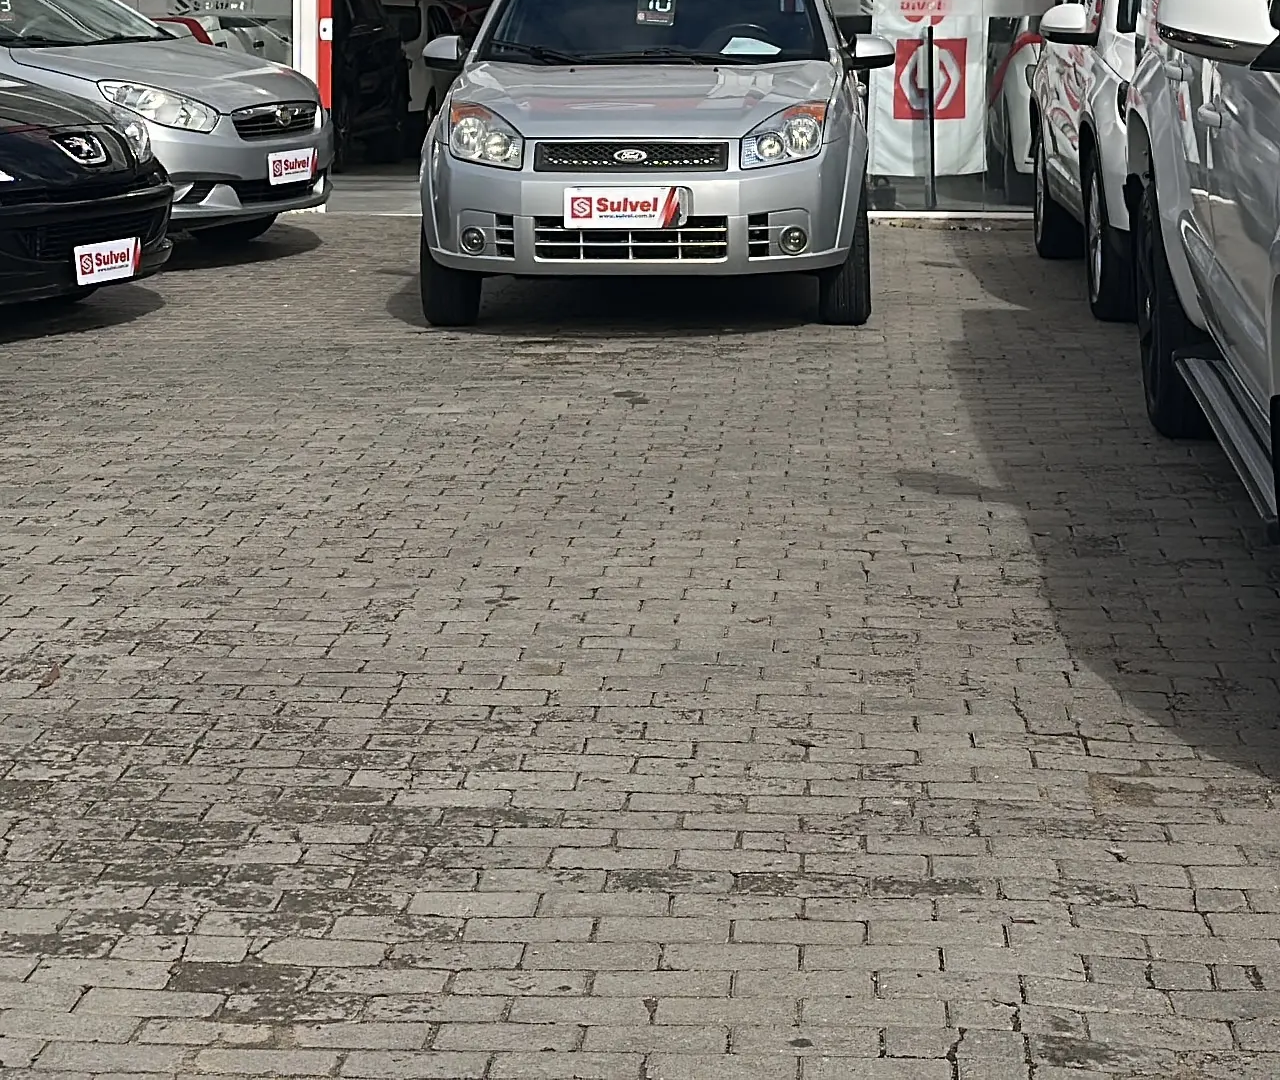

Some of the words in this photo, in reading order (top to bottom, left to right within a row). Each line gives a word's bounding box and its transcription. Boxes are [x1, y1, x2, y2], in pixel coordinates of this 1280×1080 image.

[284, 156, 309, 171] Sulvel
[596, 197, 658, 213] Sulvel
[95, 248, 130, 267] Sulvel
